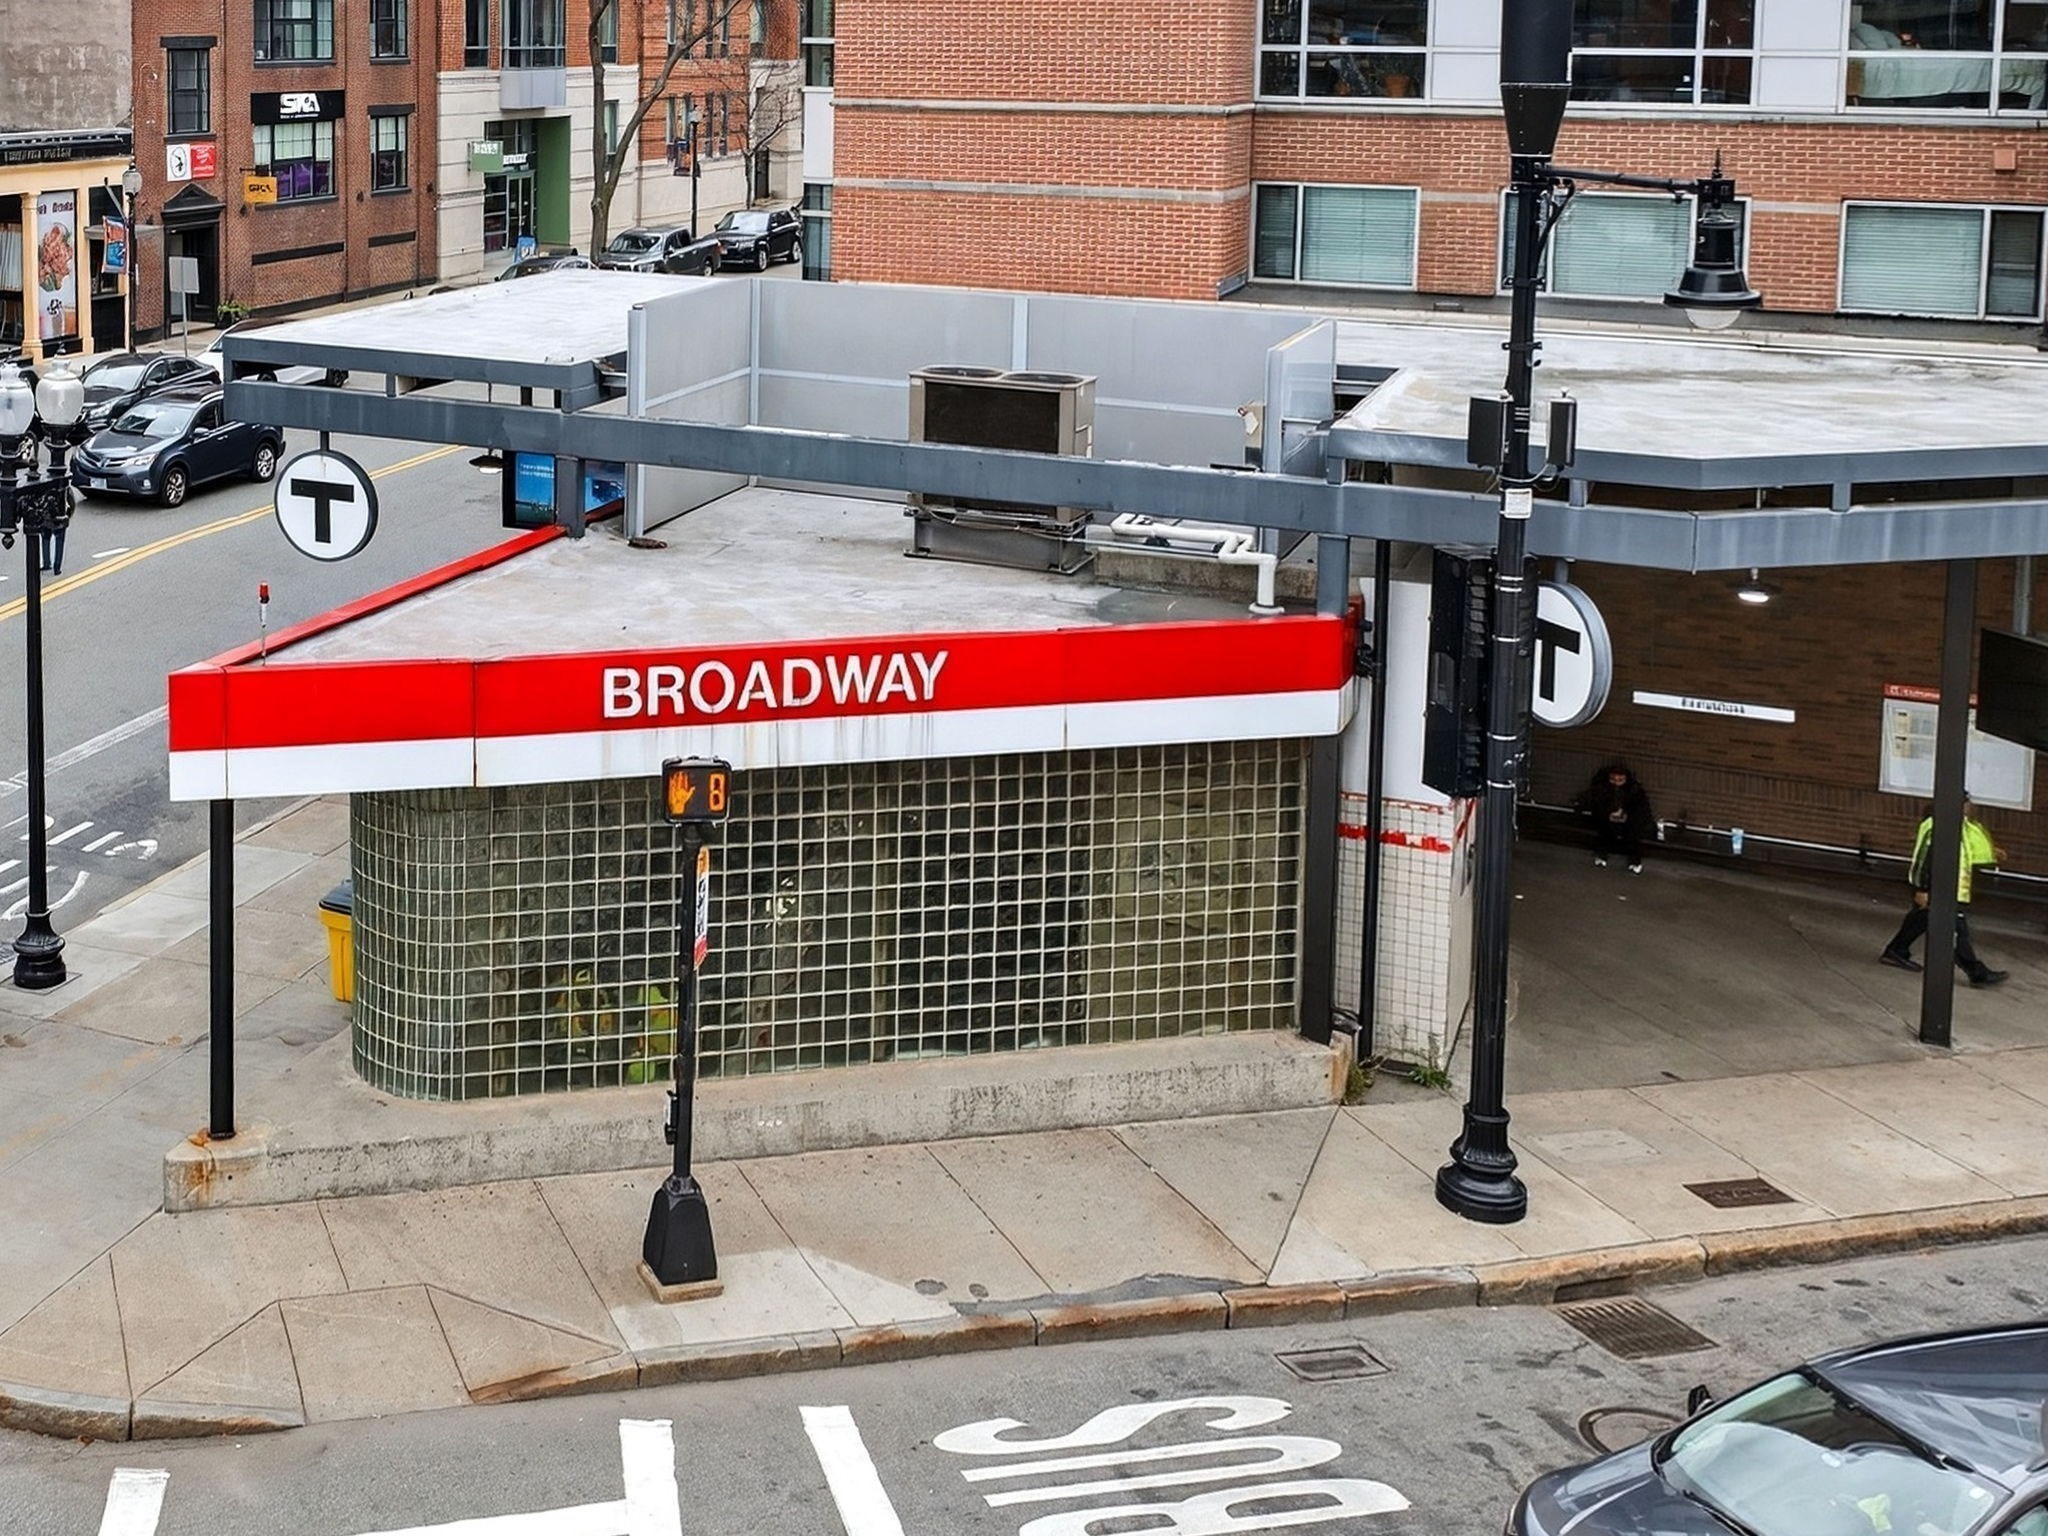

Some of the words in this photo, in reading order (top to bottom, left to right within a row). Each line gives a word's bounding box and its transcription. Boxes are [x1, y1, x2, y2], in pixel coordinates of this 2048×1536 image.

[290, 477, 355, 544] T
[602, 650, 949, 719] BROADWAY
[1536, 616, 1581, 703] T
[708, 771, 727, 812] 8
[932, 1395, 1412, 1536] BUS
